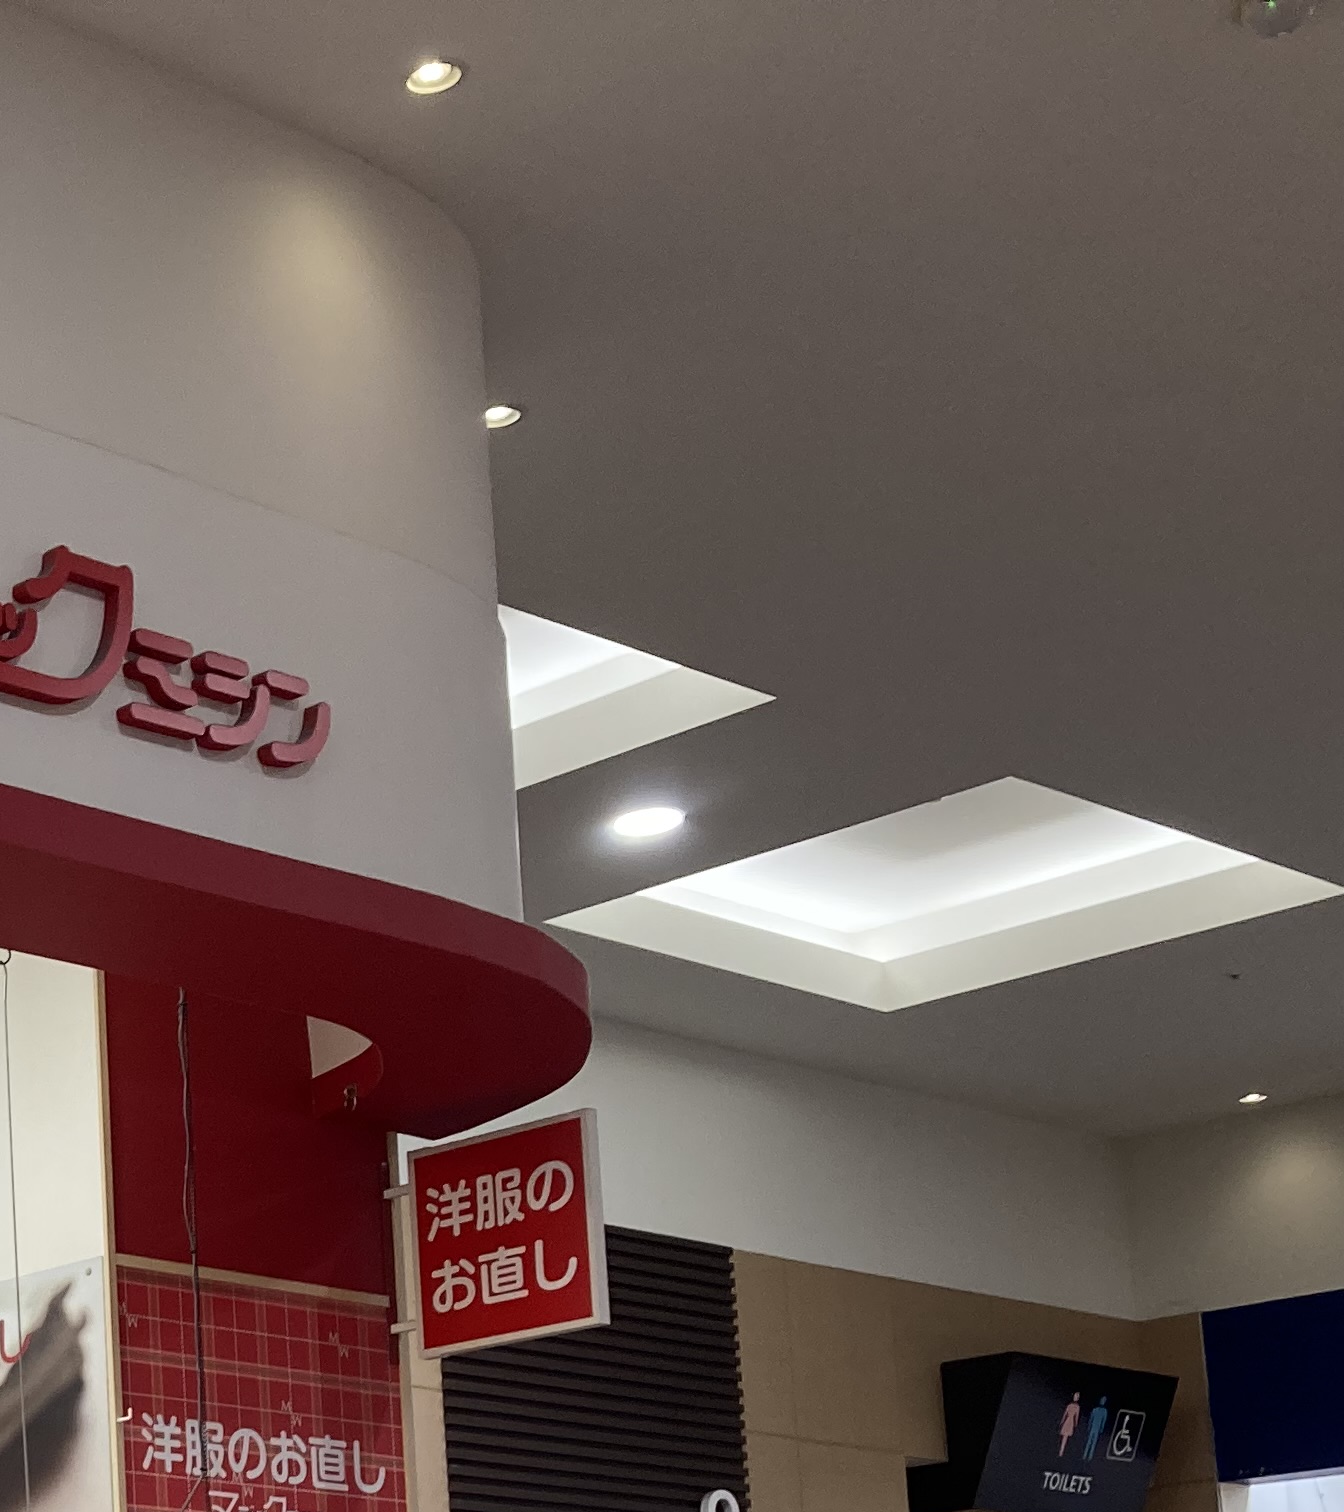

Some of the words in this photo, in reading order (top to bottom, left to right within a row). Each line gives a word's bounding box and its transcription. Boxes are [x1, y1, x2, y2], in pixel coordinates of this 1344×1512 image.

[426, 1160, 574, 1242] 洋服の
[431, 1239, 577, 1314] お直し
[142, 1412, 386, 1494] 洋服のお直し
[1042, 1471, 1094, 1495] TOILETS
